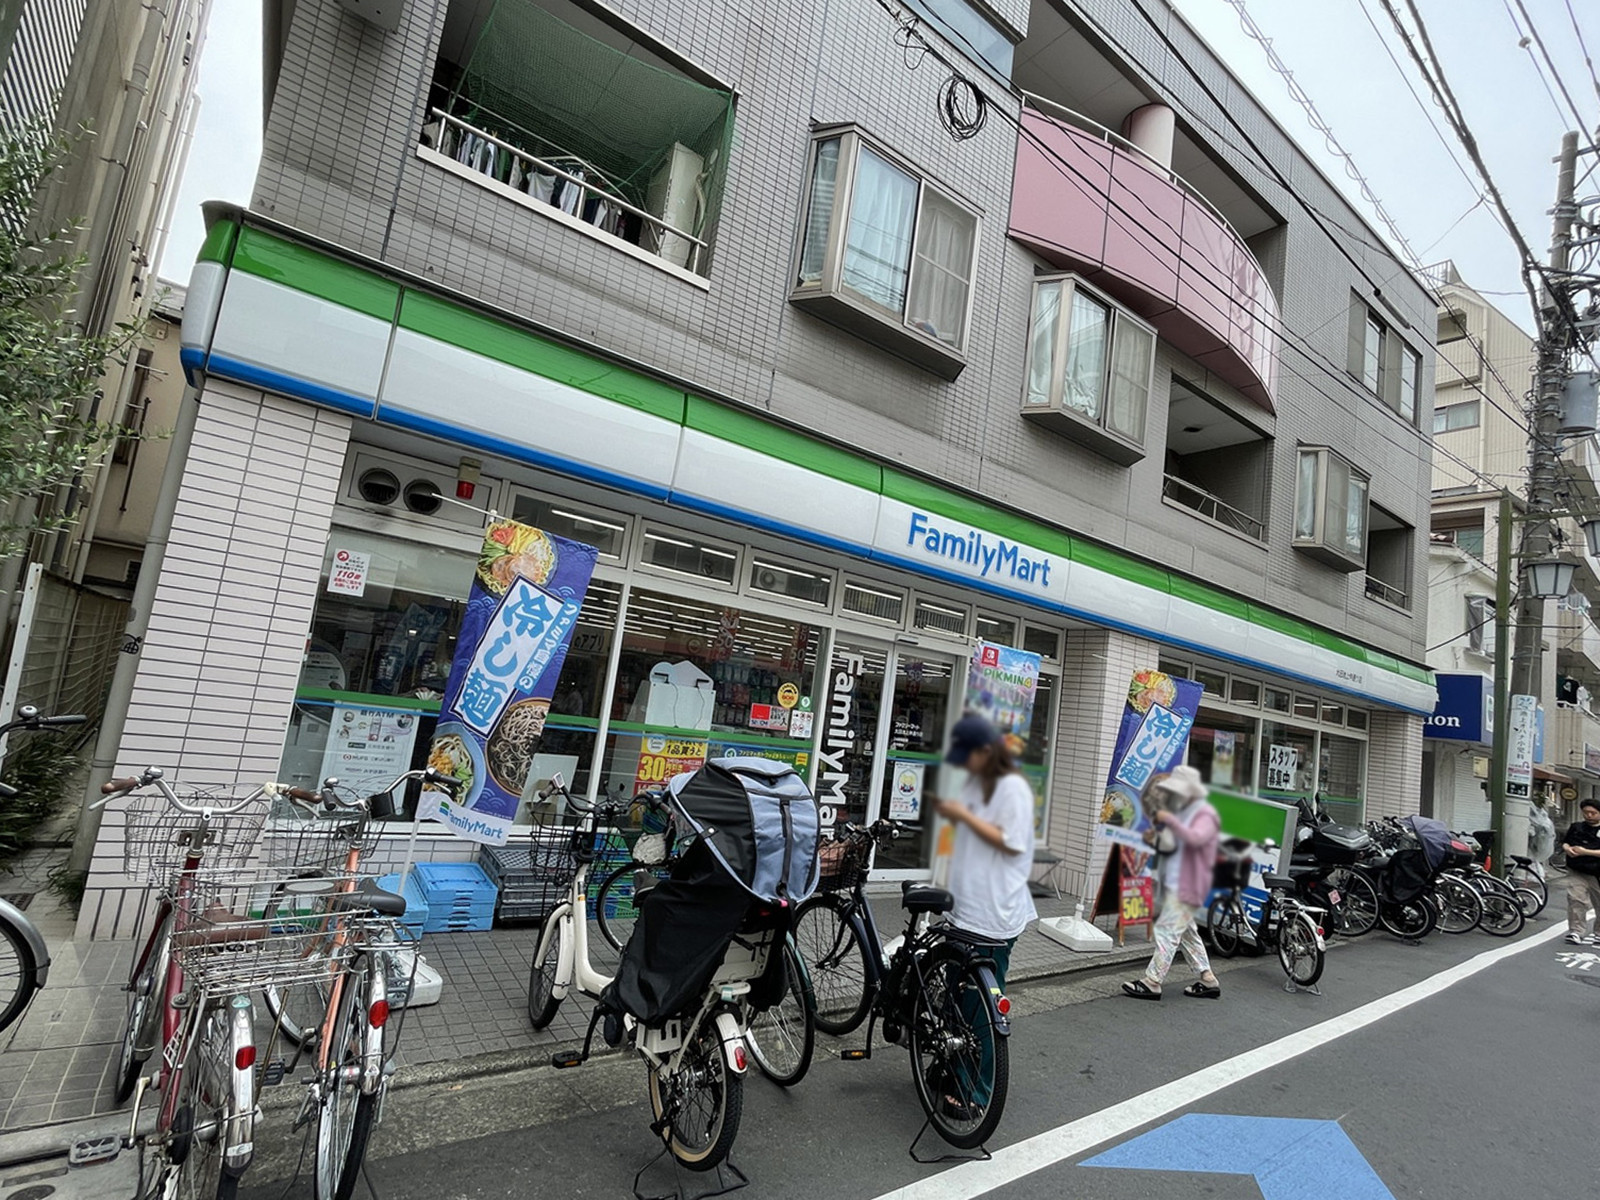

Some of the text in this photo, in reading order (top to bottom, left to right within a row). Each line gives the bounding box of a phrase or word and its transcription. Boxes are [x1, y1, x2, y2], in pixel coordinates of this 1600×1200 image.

[908, 512, 1051, 587] FamilyMart
[459, 584, 554, 728] 冷し麺
[818, 650, 866, 841] FamilyMar
[1425, 715, 1461, 728] ion
[638, 756, 665, 782] 30
[1118, 706, 1177, 788] 冷し麺
[1270, 747, 1297, 768] スタッフ
[1268, 767, 1291, 787] 募集中
